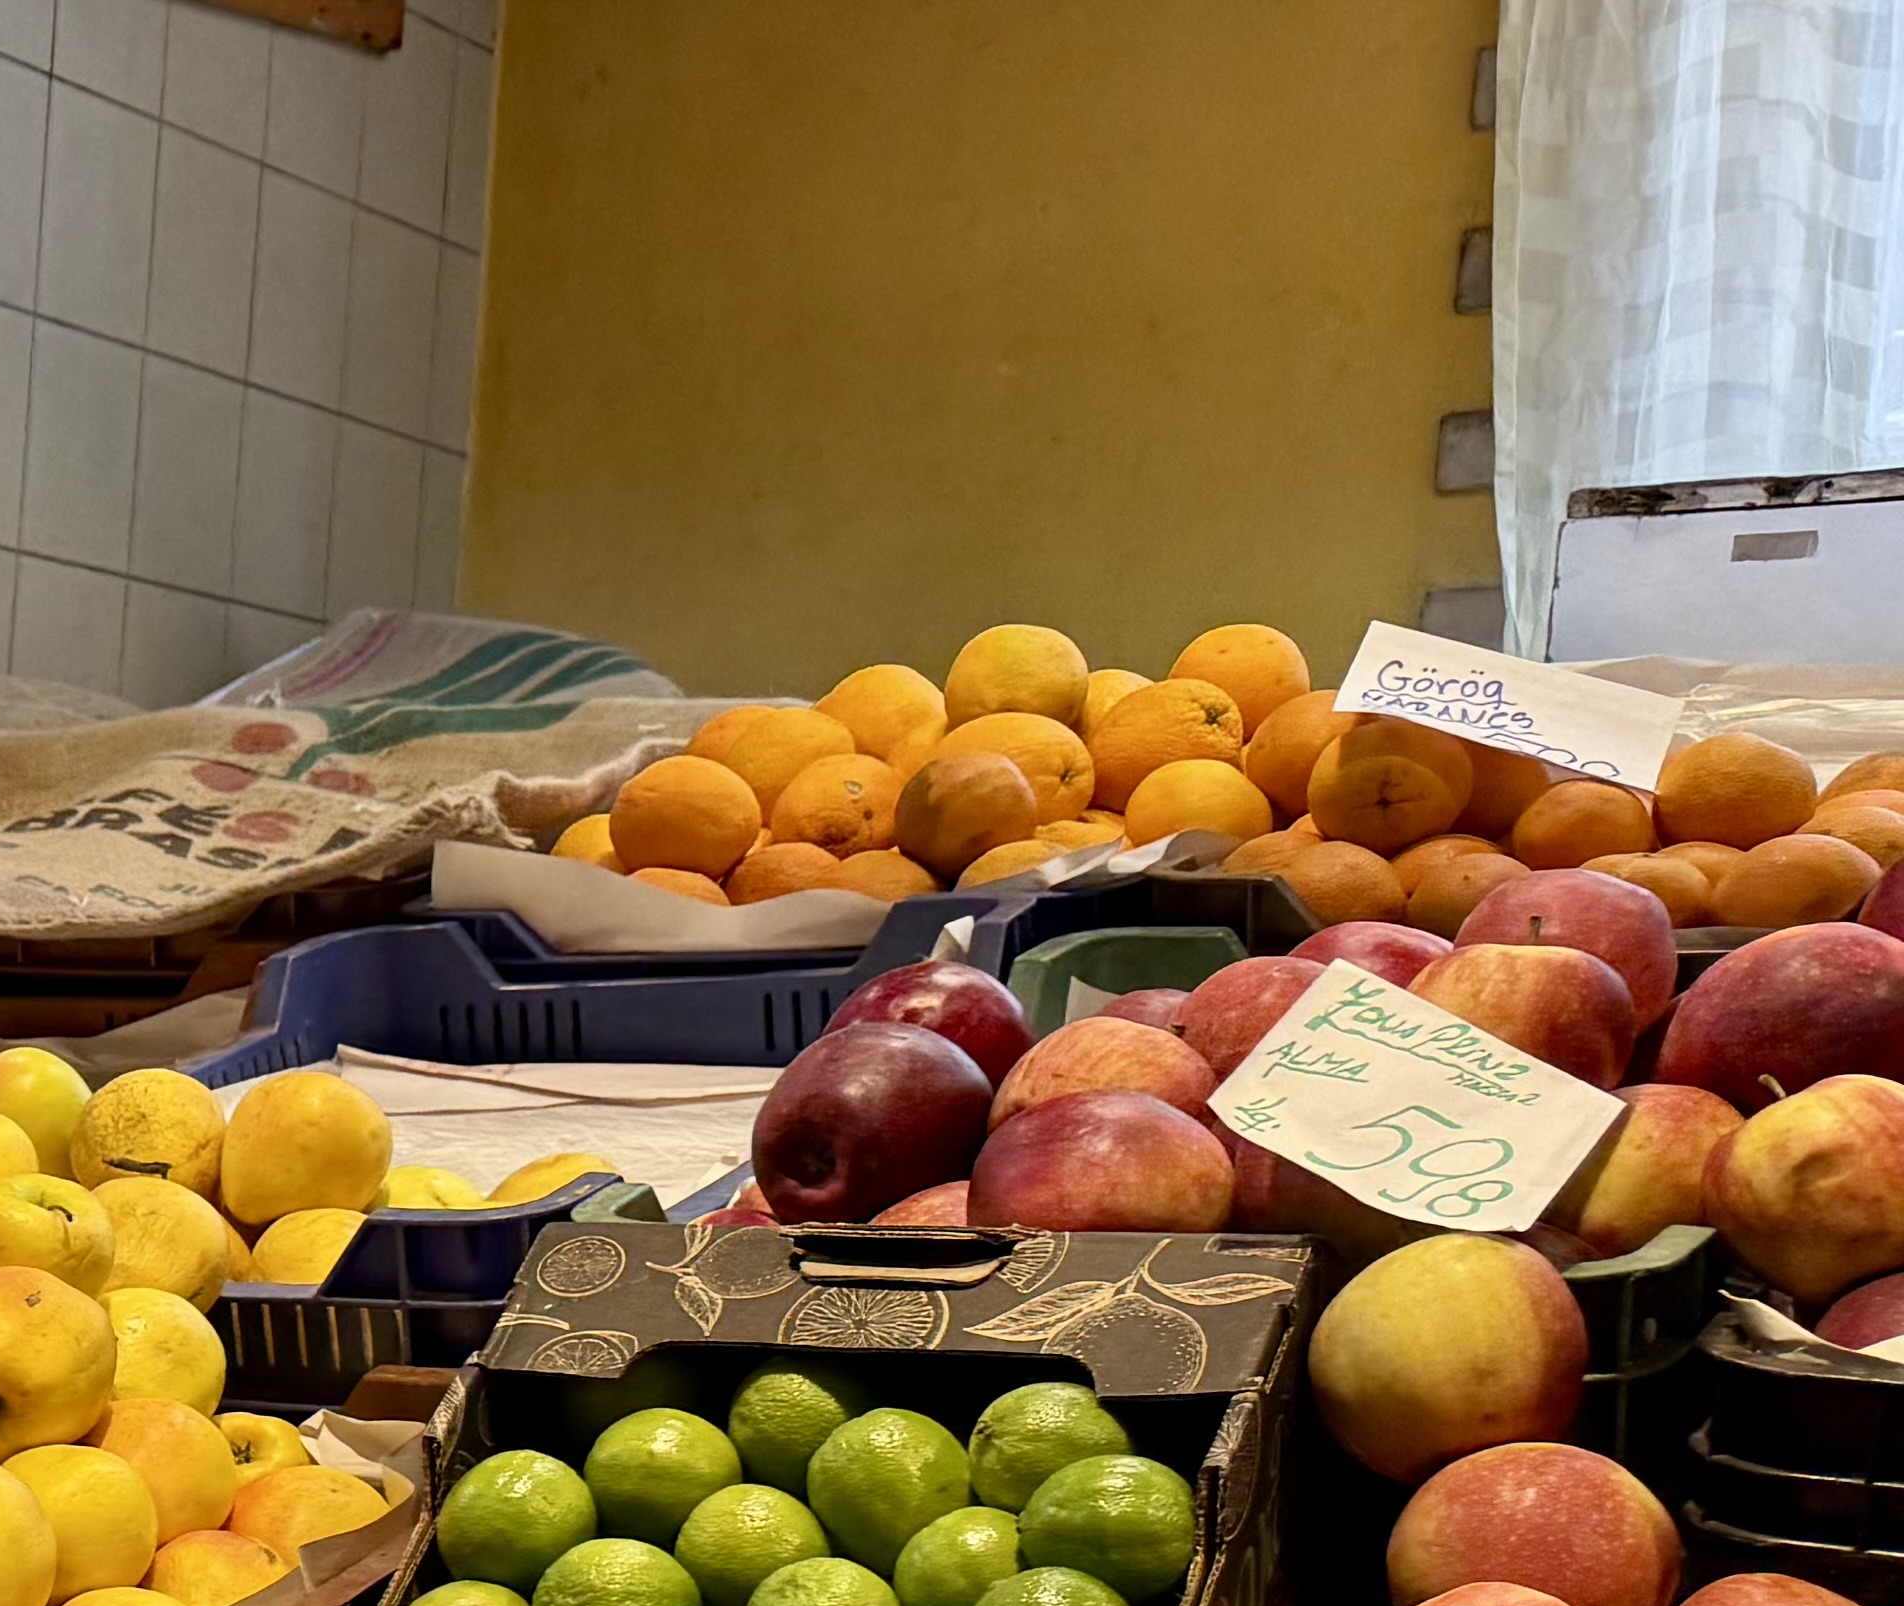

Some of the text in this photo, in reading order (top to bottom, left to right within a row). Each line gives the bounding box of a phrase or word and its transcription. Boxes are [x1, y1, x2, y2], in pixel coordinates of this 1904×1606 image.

[1375, 658, 1505, 707] Görög
[1267, 1040, 1372, 1079] ALMA
[1304, 1104, 1515, 1218] 598
